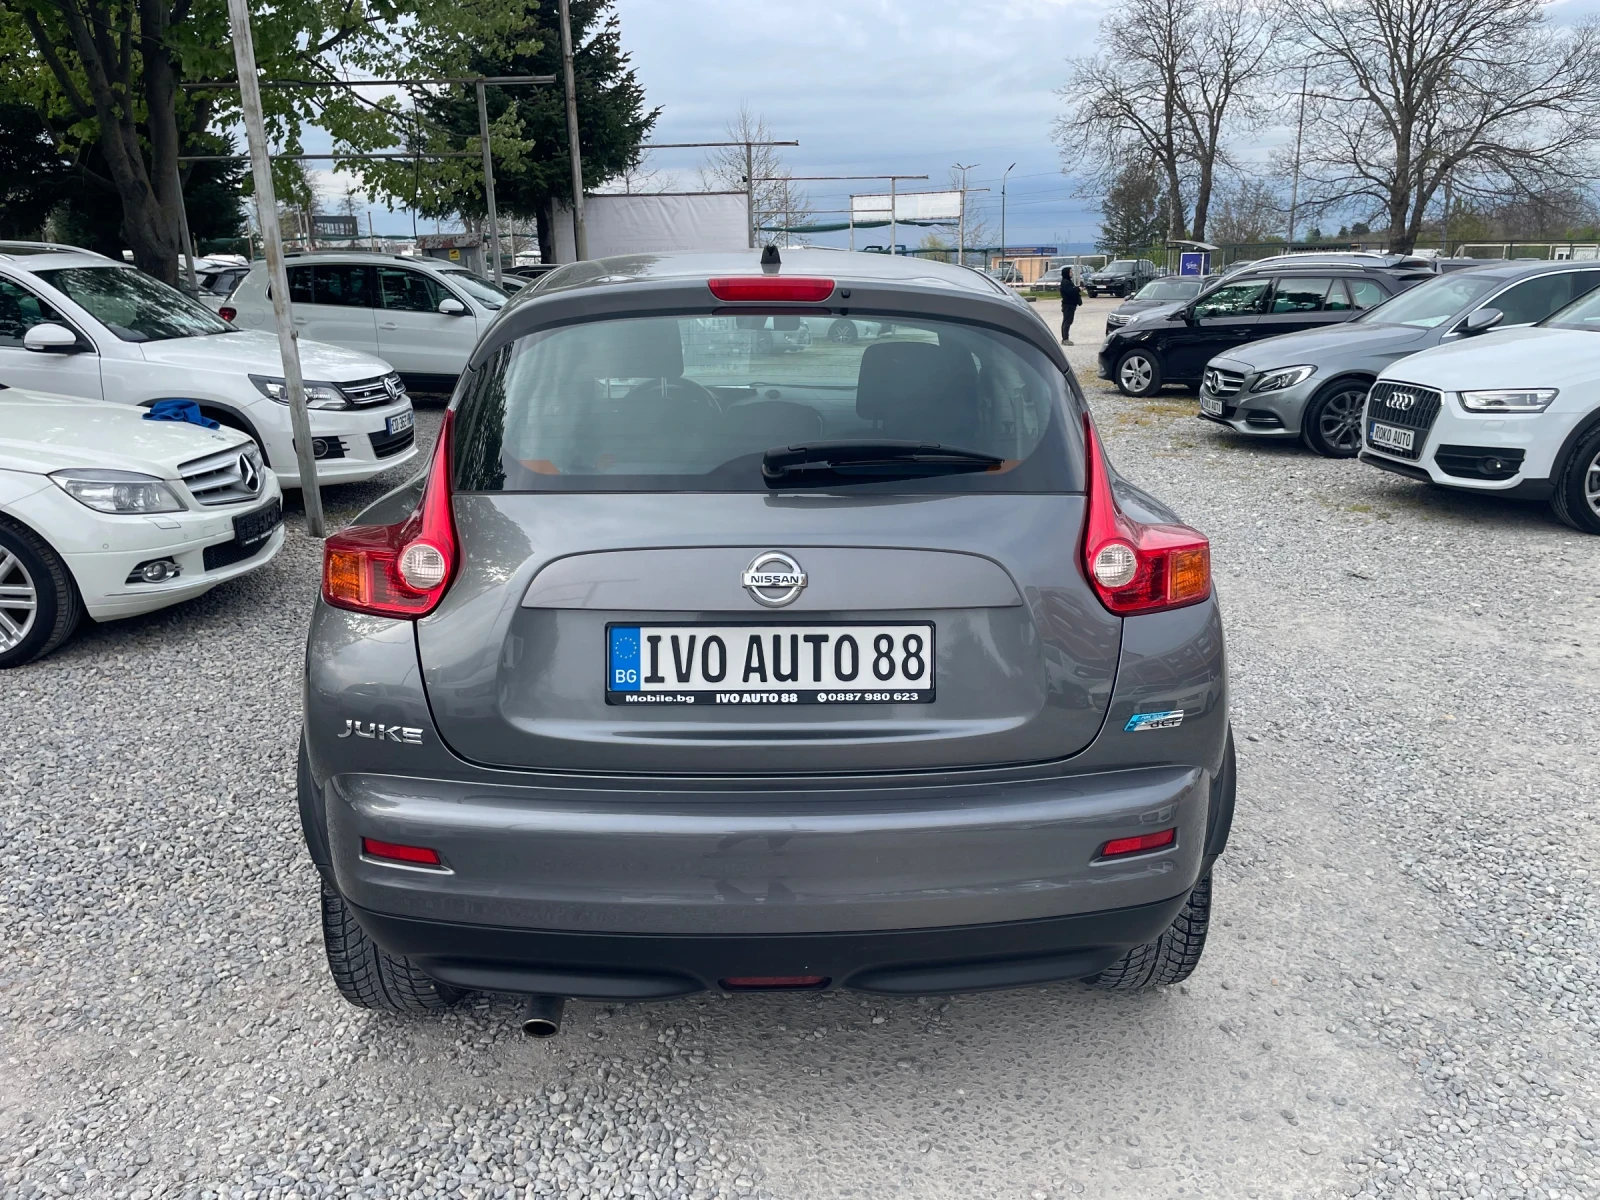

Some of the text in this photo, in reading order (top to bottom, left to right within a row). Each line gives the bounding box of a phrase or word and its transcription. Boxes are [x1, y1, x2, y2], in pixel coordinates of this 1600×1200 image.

[1374, 425, 1392, 442] ROKO
[1392, 430, 1411, 447] AUTO
[750, 575, 799, 584] NISSAN
[644, 633, 925, 684] IVO AUTO 88
[615, 669, 637, 684] BG
[625, 692, 919, 704] Mobile.bg IVO AUTO 88 0887 980 623
[337, 719, 424, 745] JUKE
